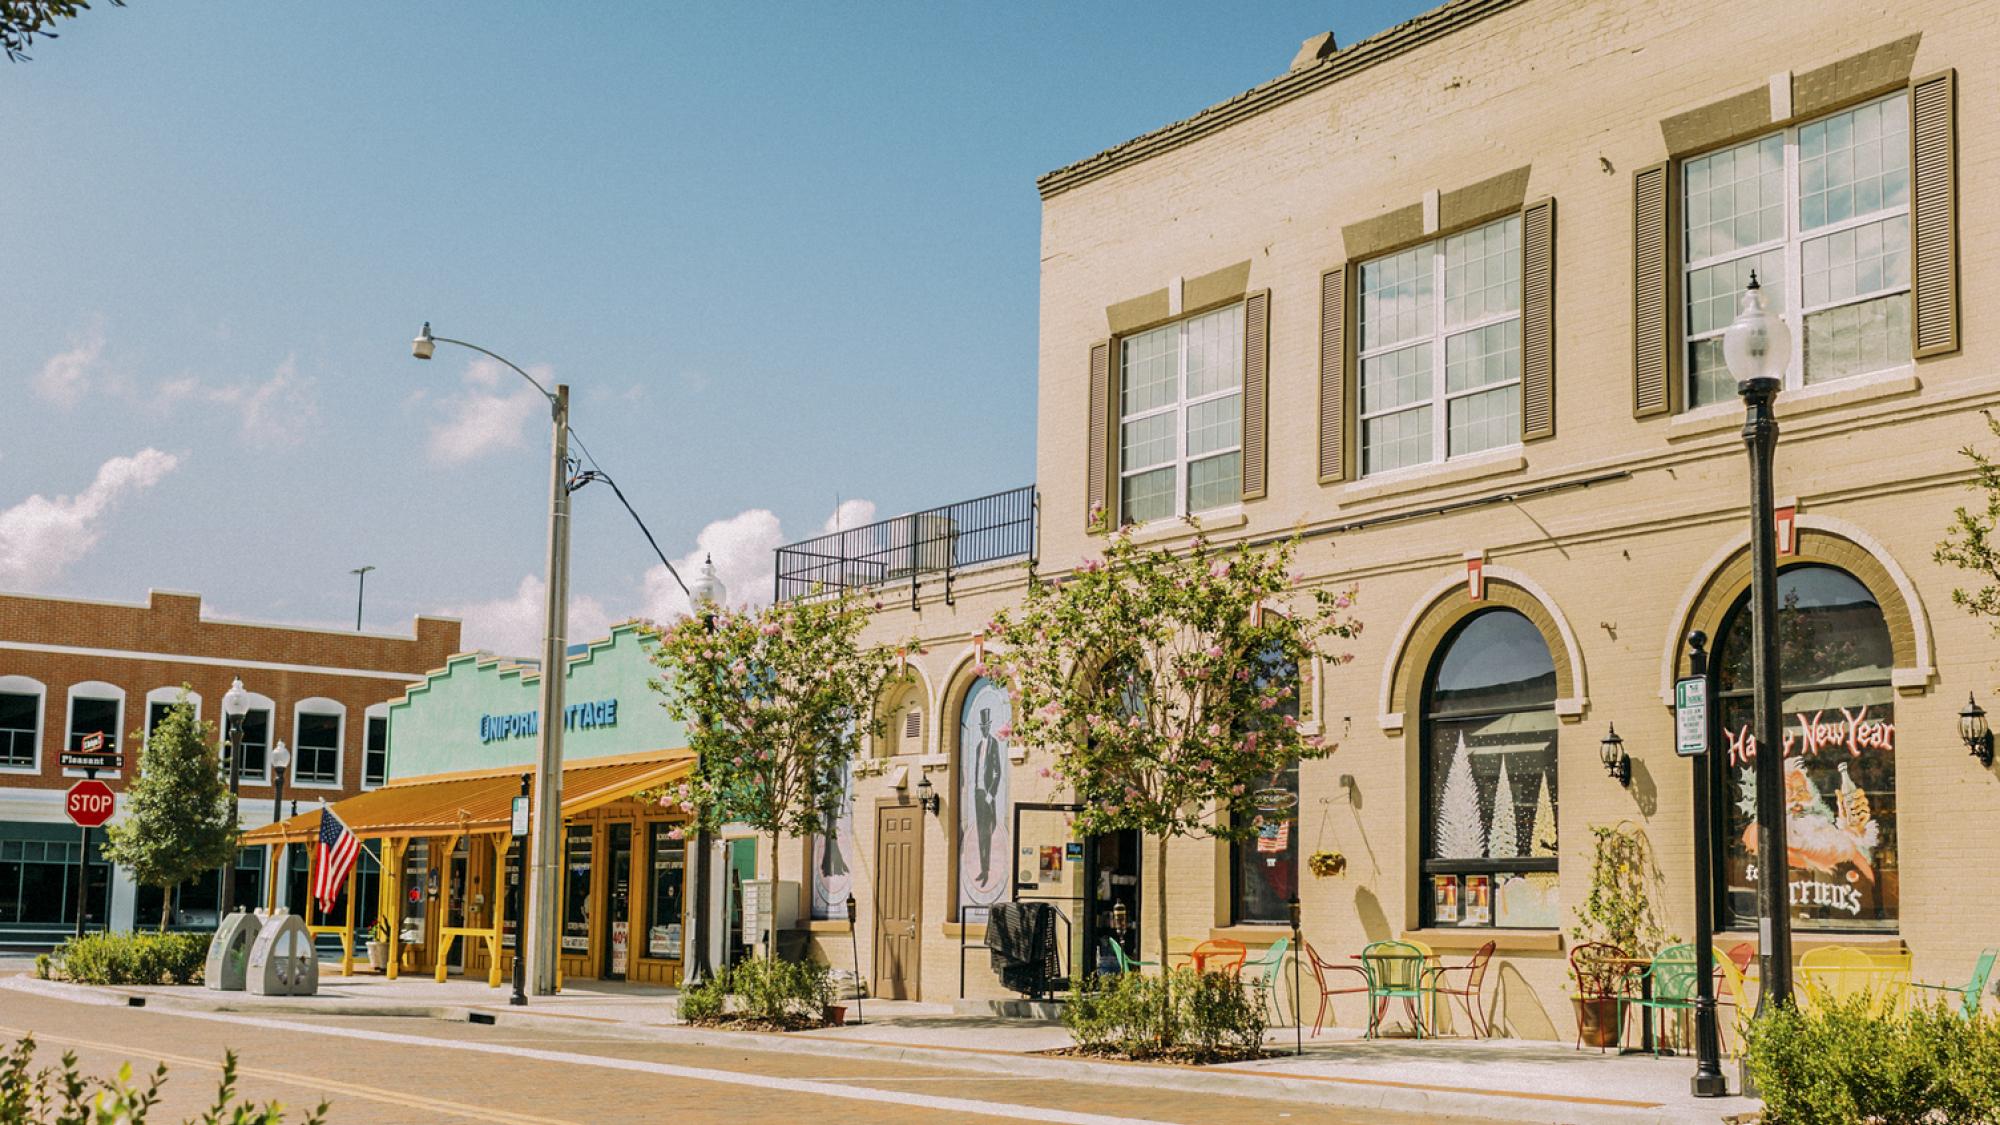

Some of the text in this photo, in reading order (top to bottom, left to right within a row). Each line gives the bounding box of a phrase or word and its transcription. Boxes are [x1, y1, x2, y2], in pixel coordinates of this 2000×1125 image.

[480, 699, 618, 743] UNIFORM TTAGE
[1723, 704, 1896, 769] Hay New Year
[69, 793, 113, 813] STOP
